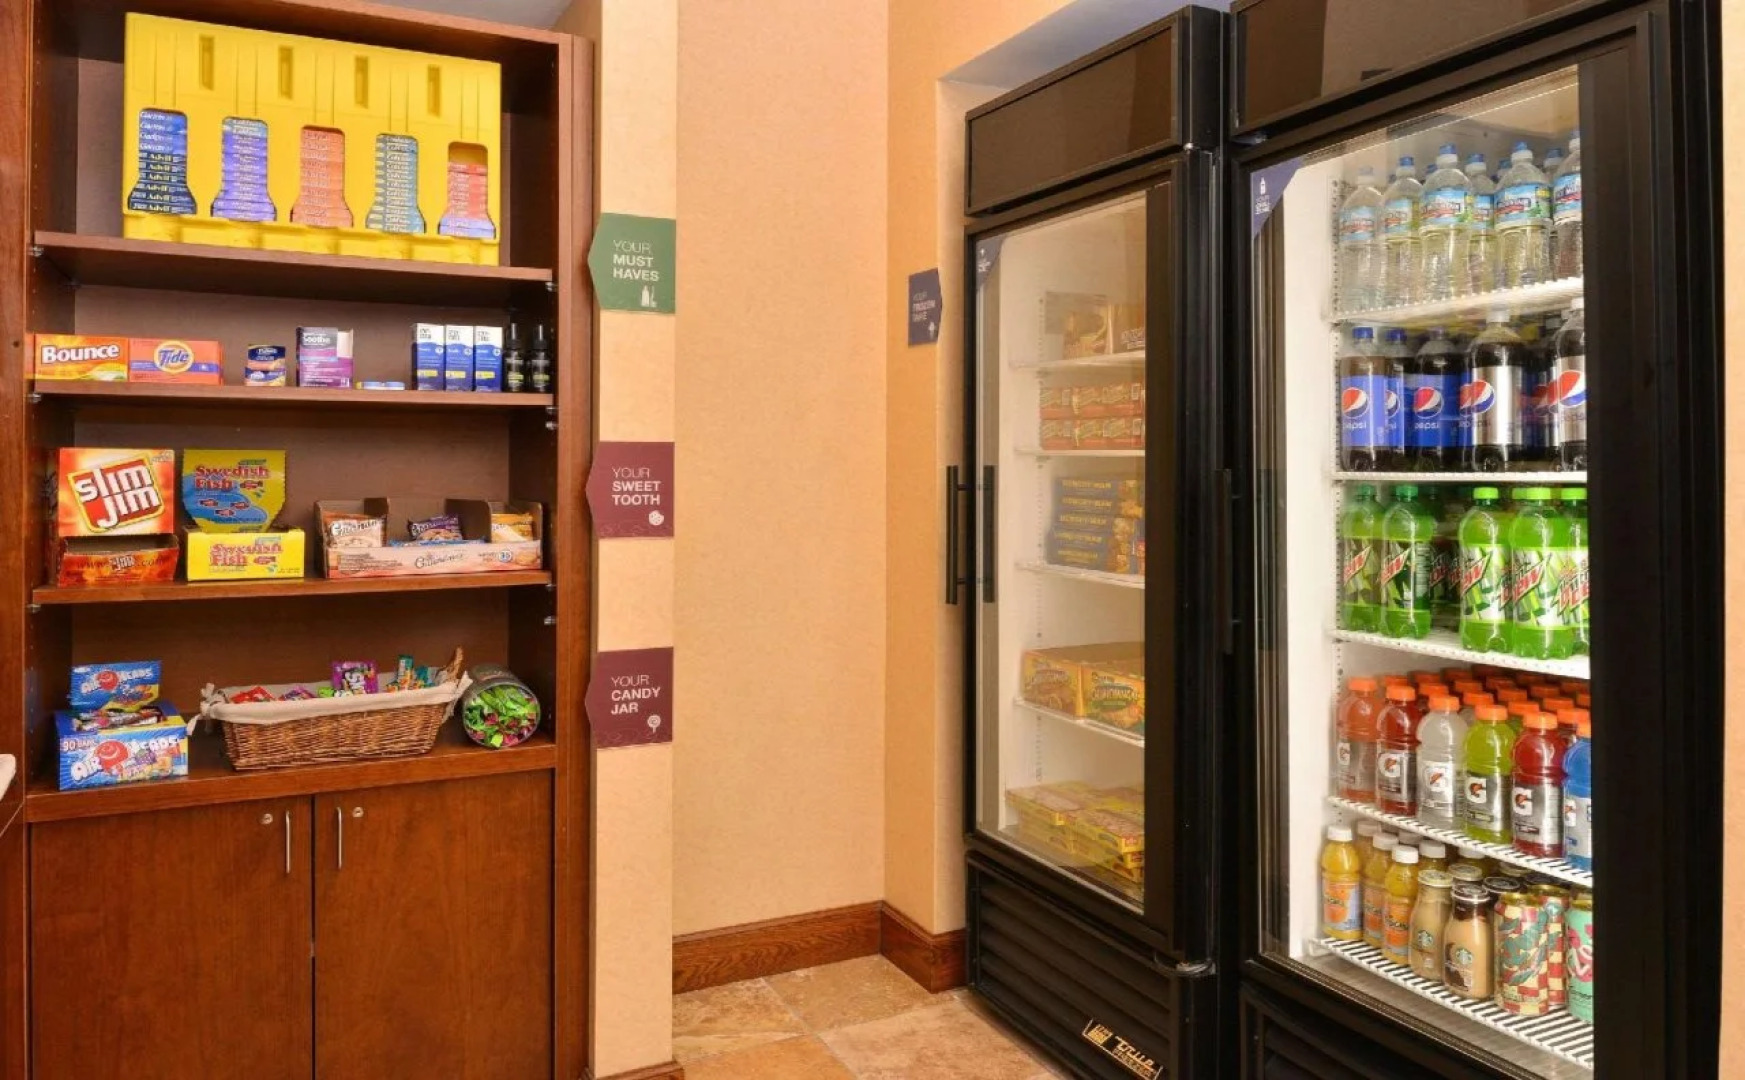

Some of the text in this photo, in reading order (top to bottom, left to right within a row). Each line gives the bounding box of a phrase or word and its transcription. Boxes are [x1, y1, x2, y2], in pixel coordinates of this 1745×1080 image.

[613, 240, 651, 253] YOUR
[613, 254, 653, 267] MUST
[612, 267, 659, 281] HAVES
[41, 344, 119, 364] Bounce
[159, 349, 188, 367] Tide
[195, 465, 269, 480] Swedish
[612, 467, 650, 478] YOUR
[75, 465, 151, 502] slim
[195, 478, 234, 492] Fish
[612, 481, 661, 492] SWEET
[612, 494, 660, 505] TOOTH
[210, 543, 282, 556] Swedish
[210, 555, 248, 568] Fish
[611, 674, 650, 687] YOUR
[611, 687, 660, 701] CANDY
[610, 702, 639, 715] JAR
[1464, 777, 1486, 804] G
[1512, 787, 1533, 816] G
